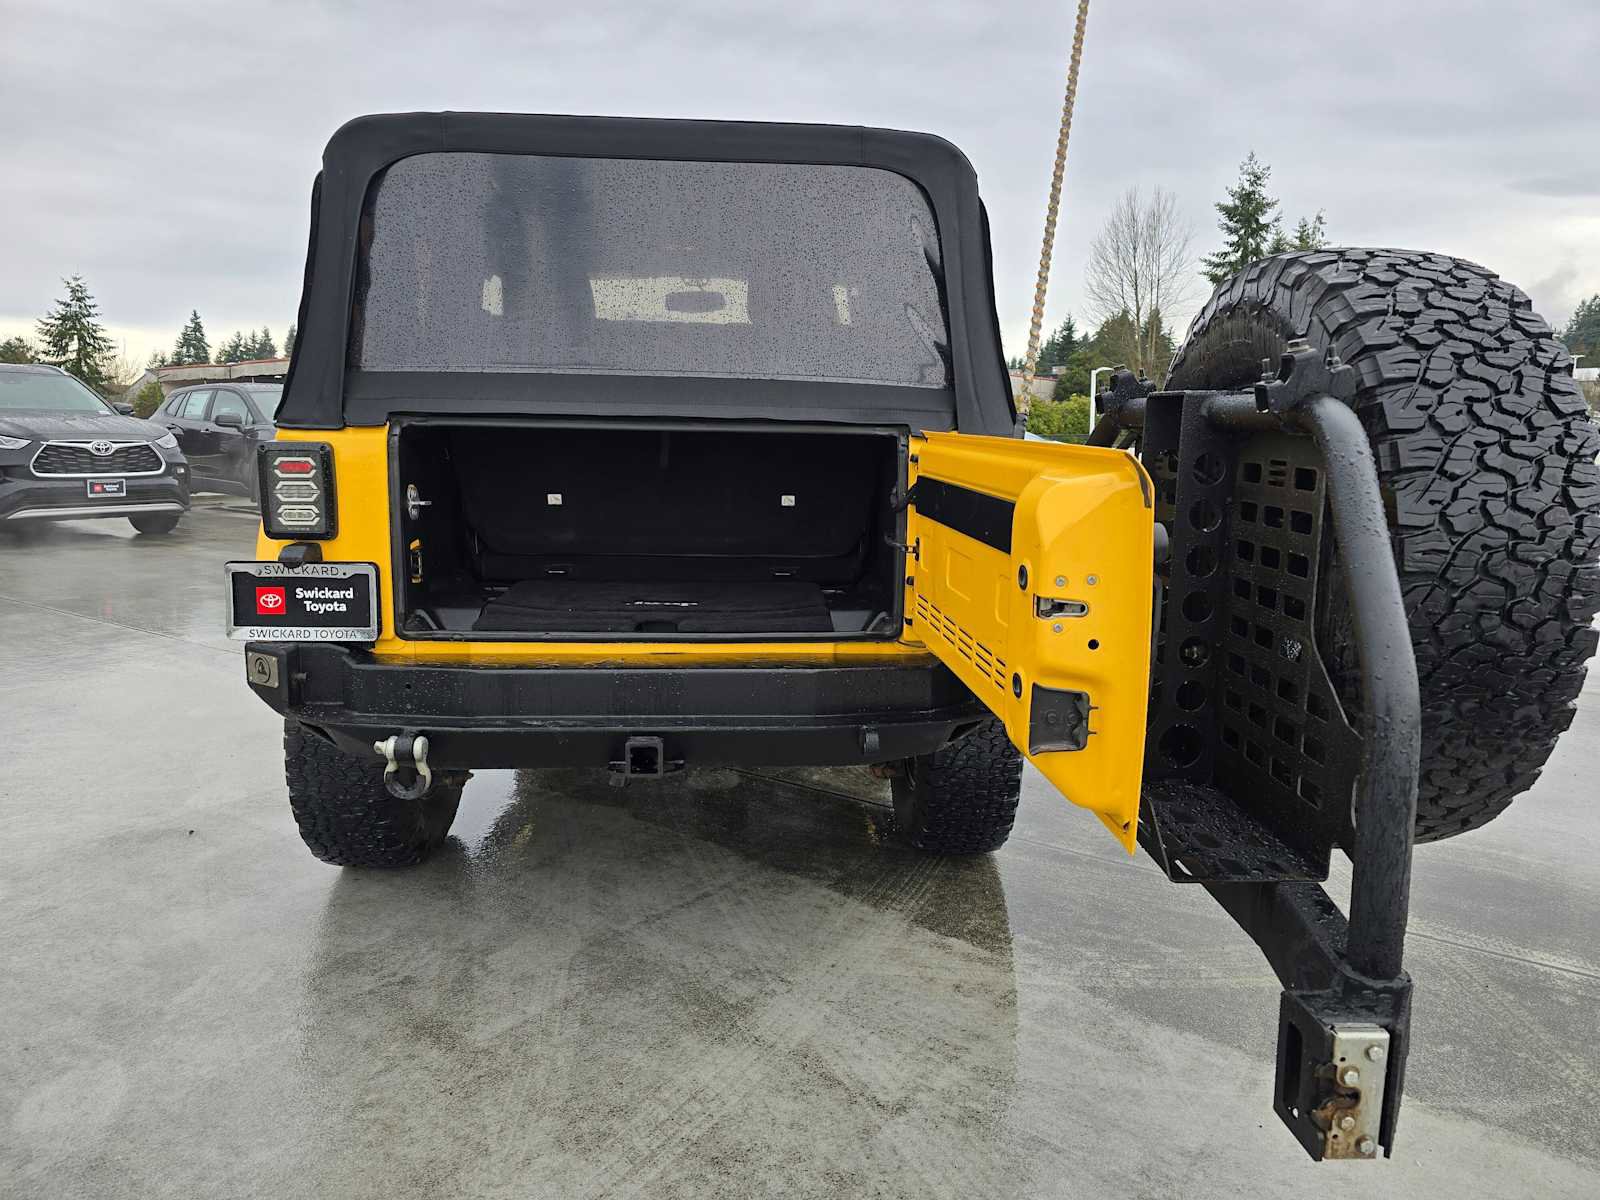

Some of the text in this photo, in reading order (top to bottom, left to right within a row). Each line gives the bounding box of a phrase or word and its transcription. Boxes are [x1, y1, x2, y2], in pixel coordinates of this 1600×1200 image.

[295, 587, 354, 599] Swickard
[304, 601, 347, 614] Toyota
[249, 629, 357, 639] SWICKARD TOYOTA
